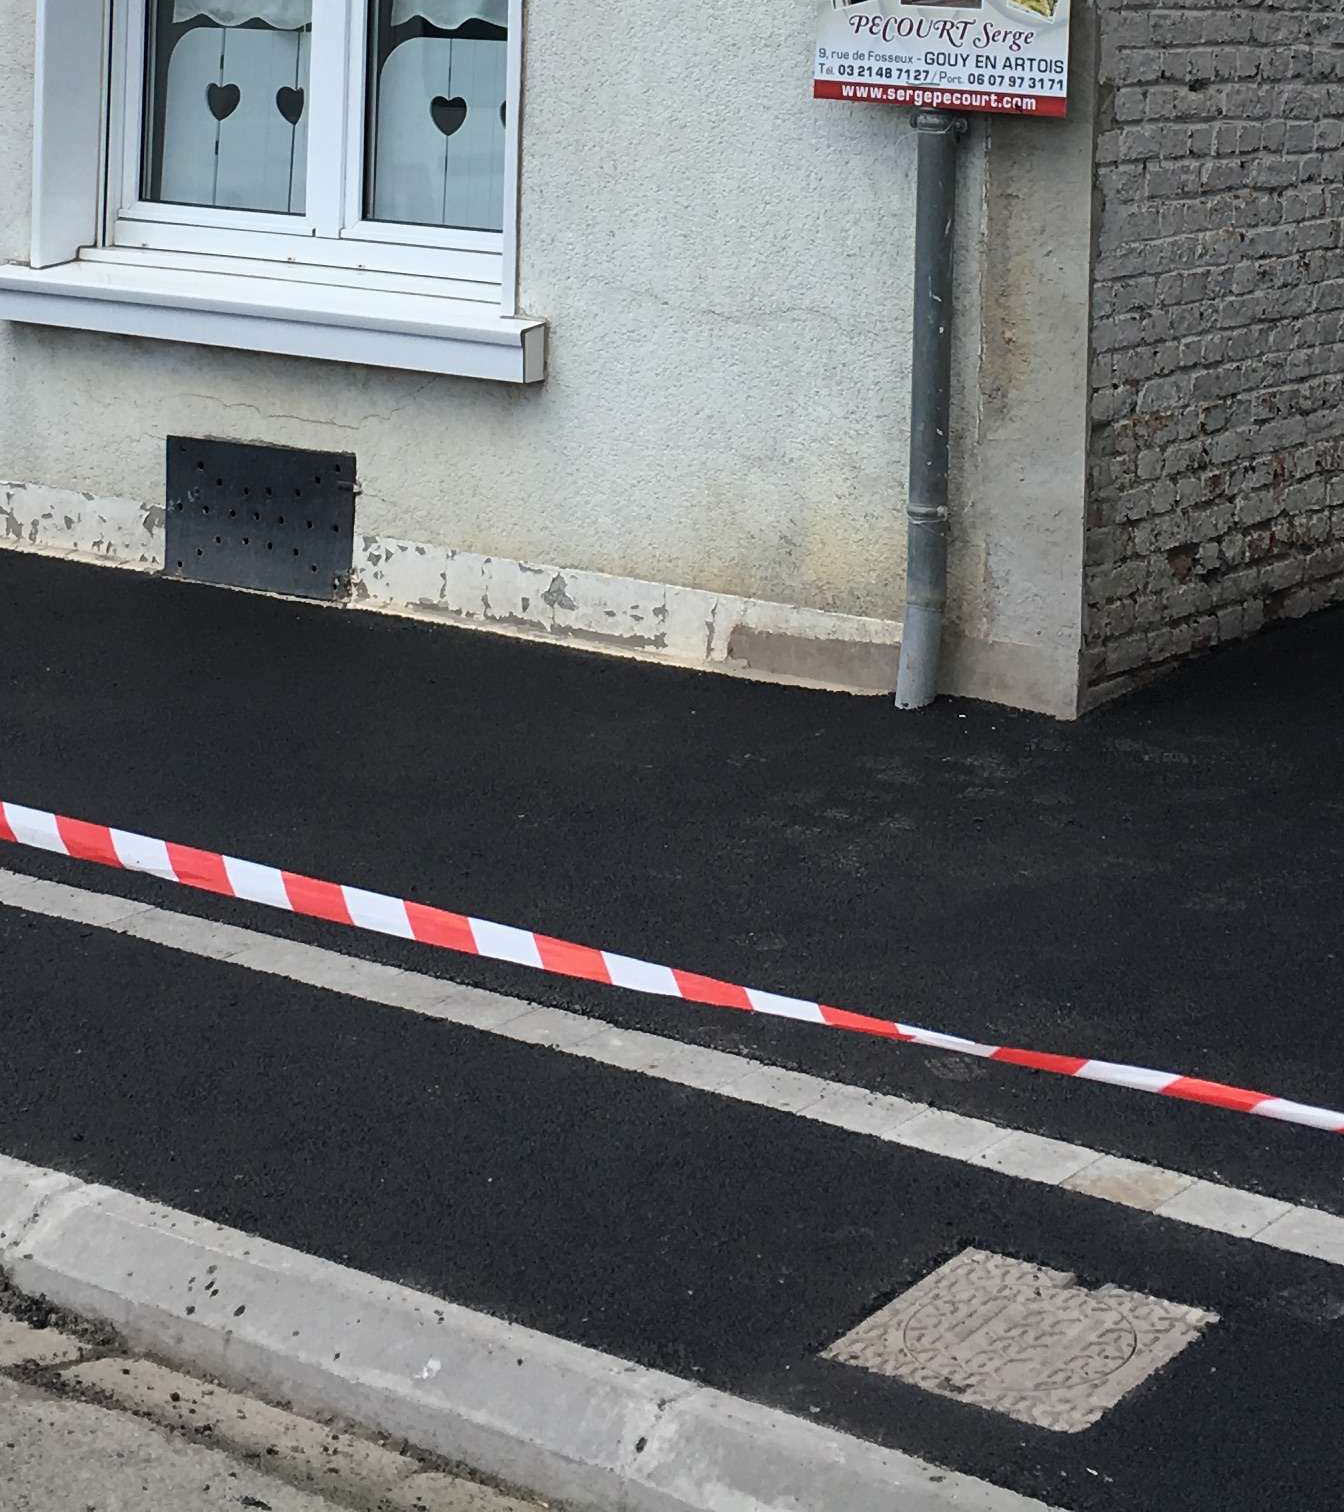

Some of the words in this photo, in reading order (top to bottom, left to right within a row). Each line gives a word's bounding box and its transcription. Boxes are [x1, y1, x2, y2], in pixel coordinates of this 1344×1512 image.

[849, 14, 976, 48] PECOURT
[972, 22, 1035, 52] Serge
[831, 50, 850, 60] rue
[852, 50, 866, 61] de
[867, 51, 914, 64] Fosseux
[924, 51, 970, 68] GOUY
[975, 54, 997, 70] EN
[1002, 57, 1065, 74] ARTOIS
[838, 65, 854, 76] 03
[857, 66, 873, 78] 21
[875, 67, 893, 79] 48
[913, 70, 930, 81] 27
[967, 73, 985, 85] 06
[988, 75, 1005, 87] 07
[1008, 76, 1025, 88] 97
[841, 85, 1037, 110] www.sergepecourt.com
